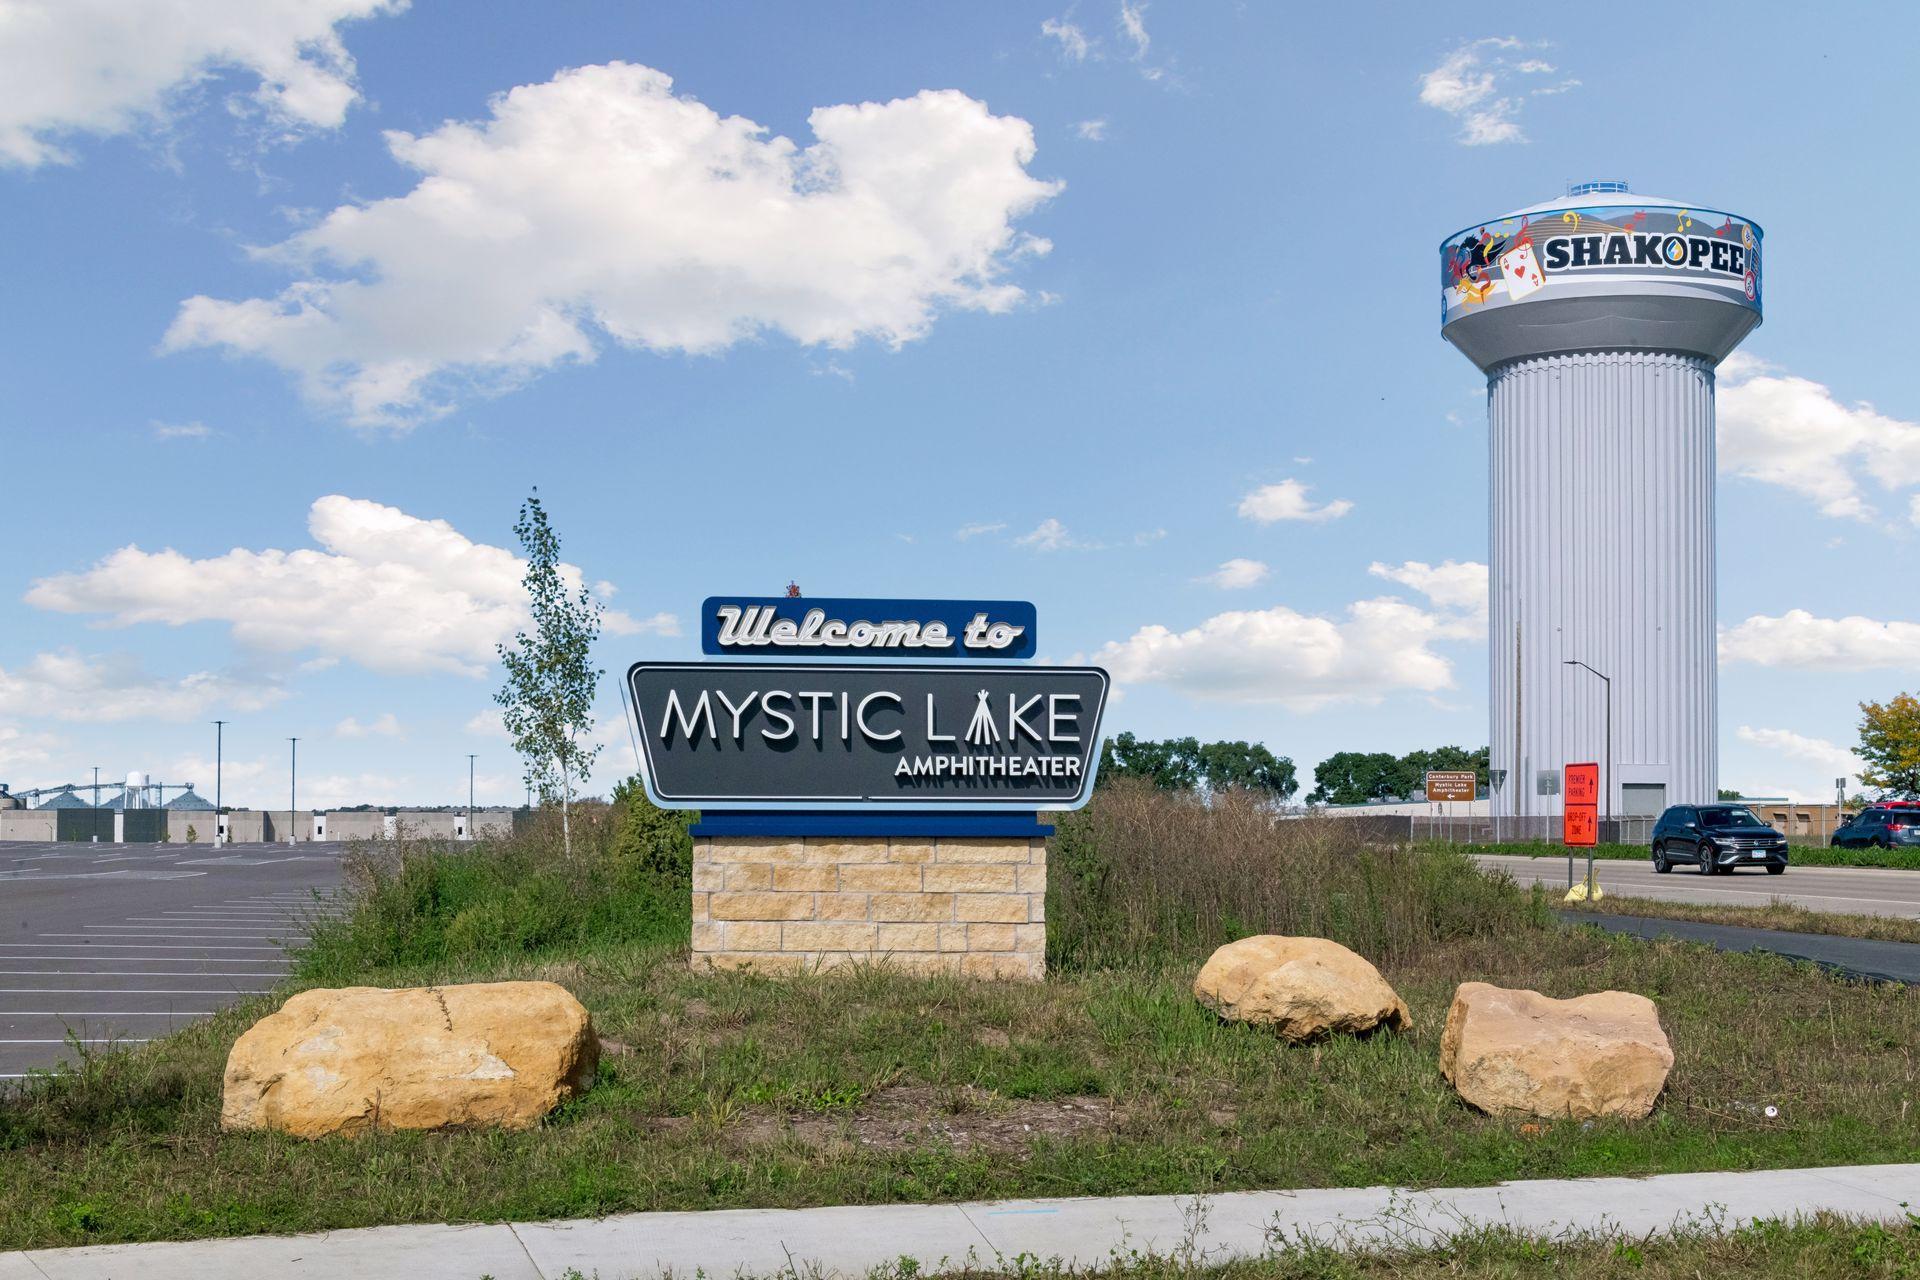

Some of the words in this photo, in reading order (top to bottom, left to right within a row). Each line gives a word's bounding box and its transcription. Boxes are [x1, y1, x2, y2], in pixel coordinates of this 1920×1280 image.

[1545, 234, 1745, 276] SHAKOPEE
[717, 605, 956, 648] Welcome
[964, 613, 1025, 649] to
[660, 689, 901, 741] MYSTIC
[927, 689, 1080, 745] LAKE
[894, 756, 1081, 776] AMPHITHEATER
